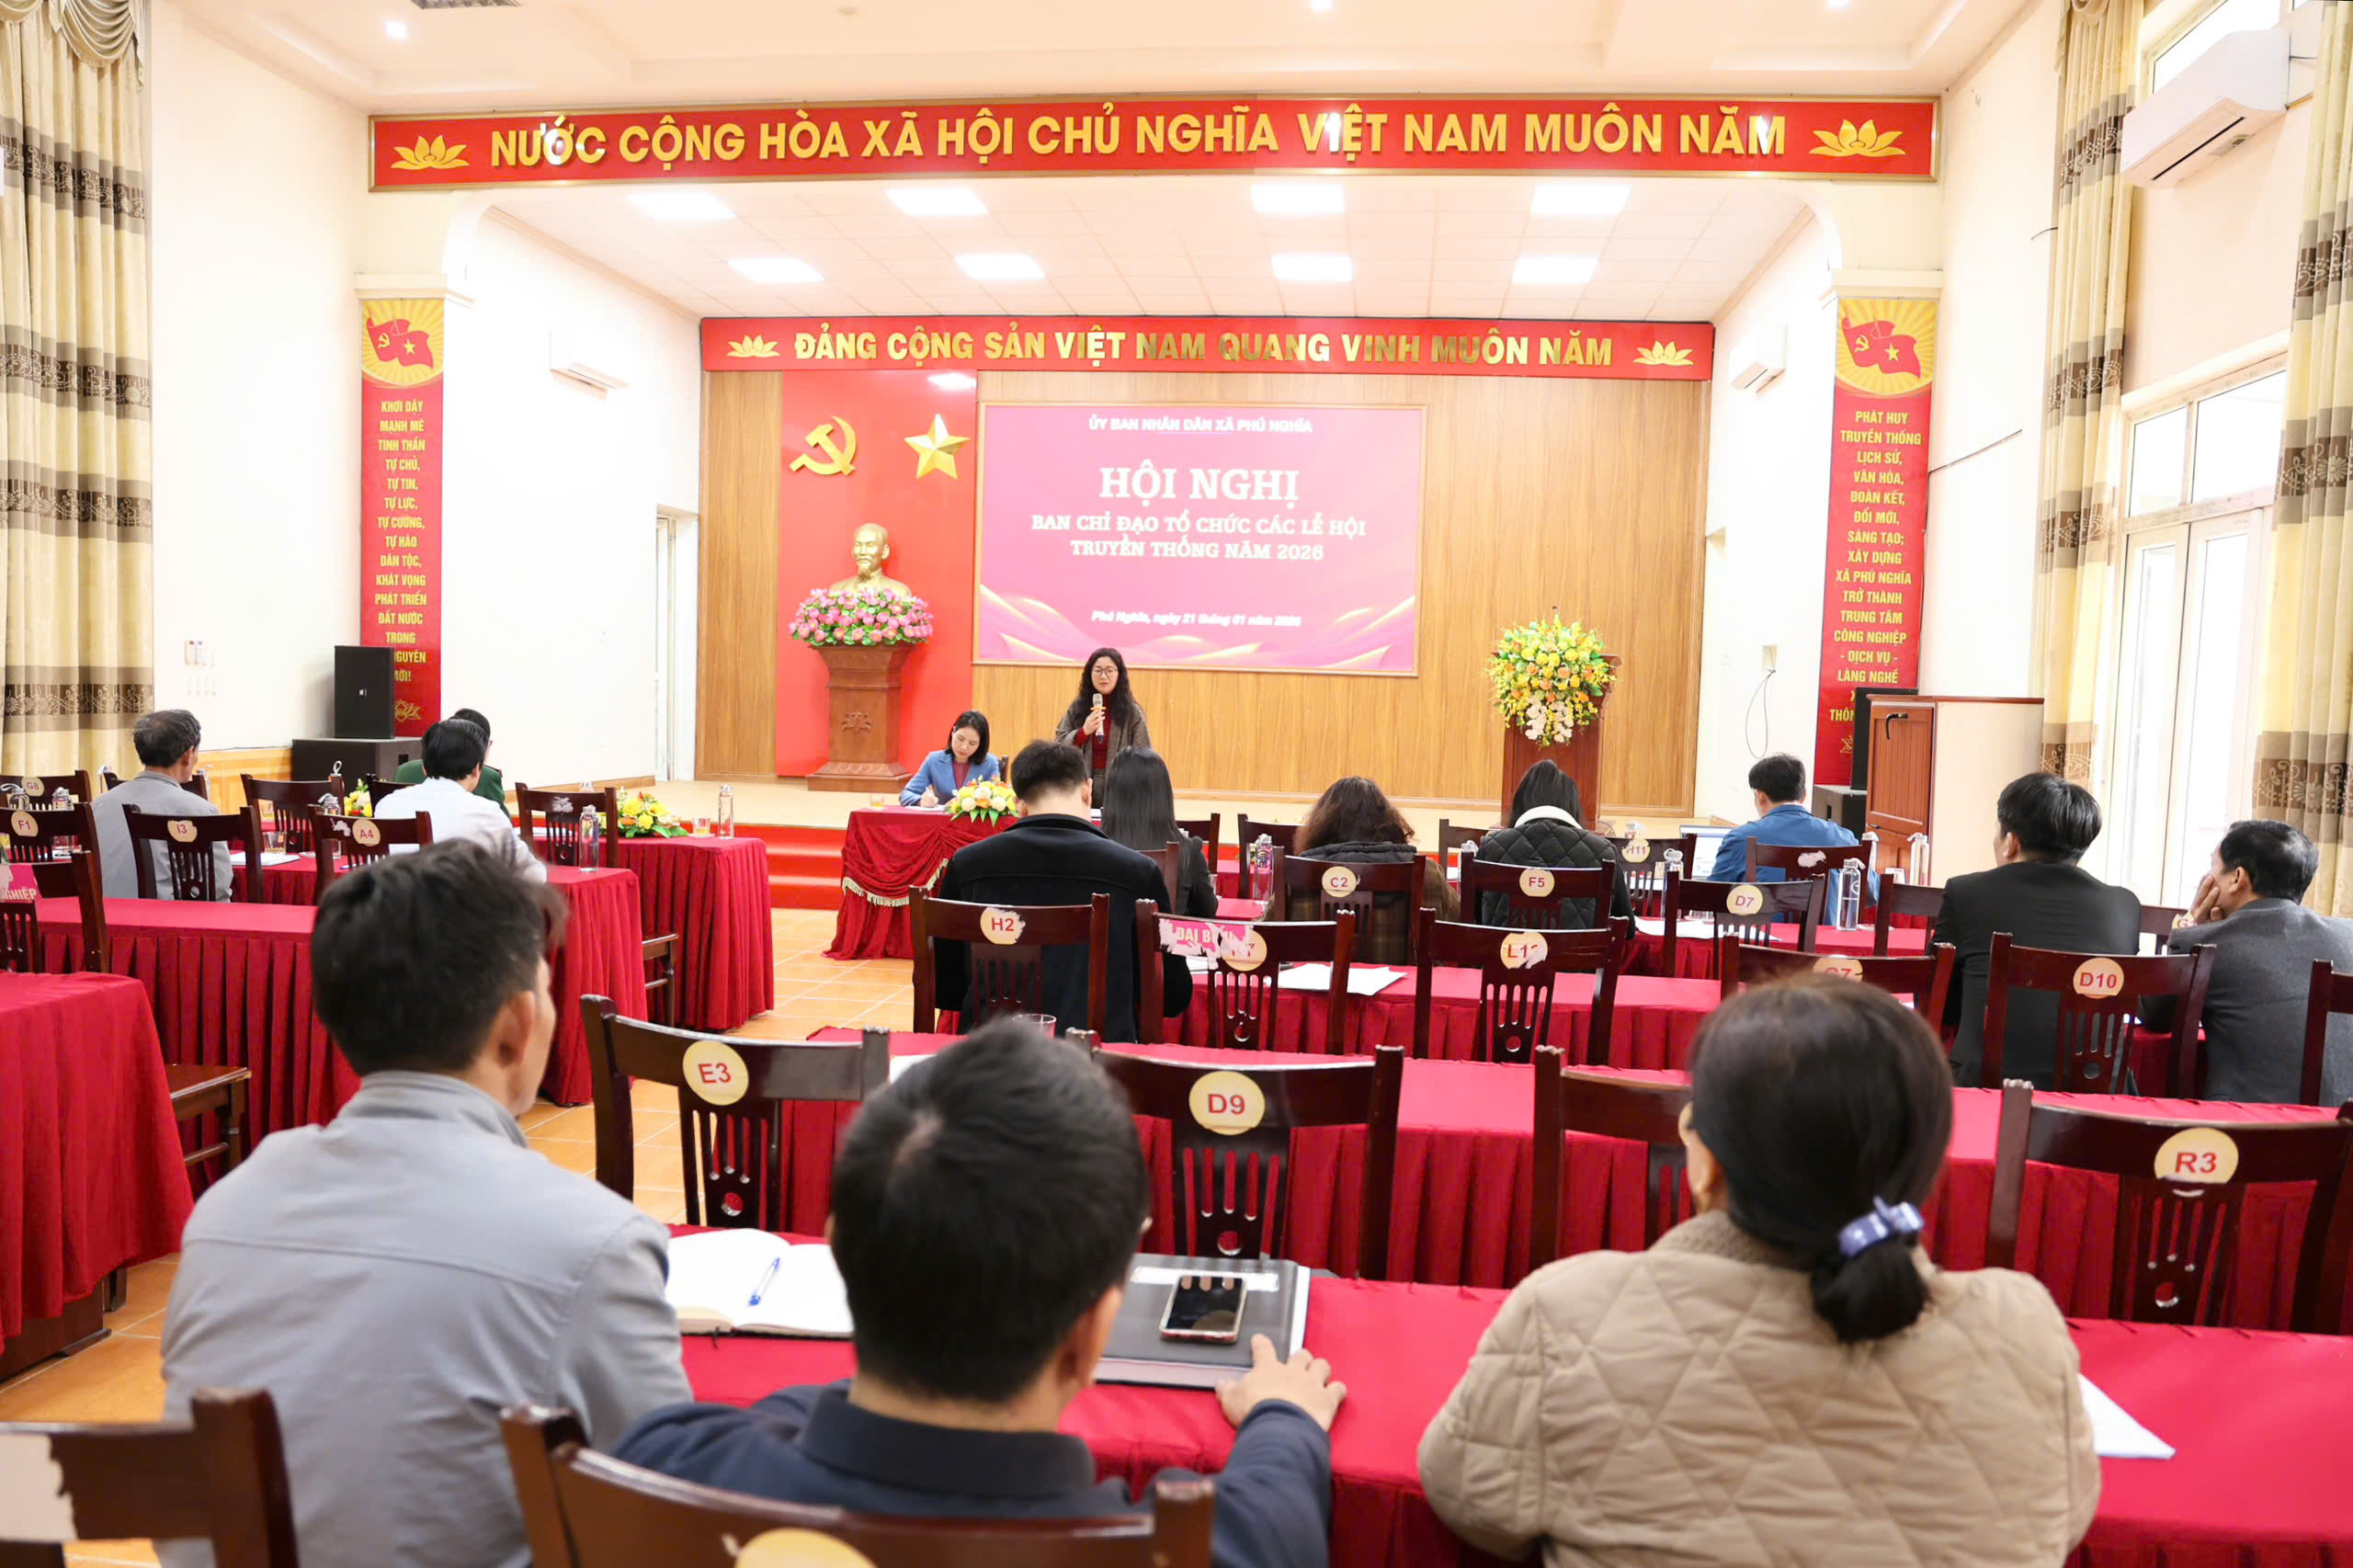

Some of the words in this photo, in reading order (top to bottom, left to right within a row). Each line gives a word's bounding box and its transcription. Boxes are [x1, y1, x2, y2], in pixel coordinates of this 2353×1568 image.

[490, 116, 607, 167] NƯỚC
[620, 114, 745, 171] CỘNG
[759, 108, 848, 160] HÒA
[861, 111, 922, 158] XÃ
[938, 107, 1014, 165] HỘI
[1028, 102, 1120, 155] CHỦ
[1135, 105, 1279, 154] NGHĨA
[1299, 103, 1386, 162] VIỆT
[1404, 113, 1508, 154] NAM
[1524, 102, 1662, 154] MUÔN
[1679, 105, 1786, 156] NĂM
[794, 323, 877, 360] ĐẢNG
[887, 324, 973, 367] CỘNG
[984, 322, 1045, 360] SẢN
[1055, 324, 1126, 367] VIỆT
[1136, 332, 1206, 361] NAM
[1218, 333, 1330, 362] QUANG
[1343, 335, 1420, 363] VINH
[1430, 327, 1529, 366] MUÔN
[1539, 330, 1612, 367] NĂM
[1856, 409, 1883, 424] PHÁT
[1886, 412, 1908, 424] HUY
[380, 420, 408, 434] MẠNH
[1110, 418, 1139, 430] BAN
[1142, 416, 1180, 431] NHÂN
[1183, 416, 1212, 431] DÂN
[1237, 417, 1265, 432] PHÚ
[1269, 417, 1314, 433] NGHĨA
[378, 439, 399, 451] TINH
[1858, 450, 1881, 466] LỊCH
[385, 459, 398, 473] TỰ
[387, 477, 399, 492] TỰ
[401, 478, 418, 490] TIN,
[1098, 460, 1176, 506] HỘI
[1189, 470, 1300, 509] NGHỊ
[384, 497, 397, 512] TỰ
[377, 517, 390, 531] TỰ
[1031, 515, 1071, 531] BAN
[1076, 511, 1111, 532] CHỈ
[1117, 516, 1159, 535] ĐẠO
[1165, 510, 1190, 532] TỔ
[1196, 514, 1250, 535] CHỨC
[1256, 514, 1295, 536] CÁC
[1301, 512, 1324, 536] LỄ
[1329, 517, 1368, 540] HỘI
[385, 536, 397, 551] TỰ
[1847, 529, 1877, 544] SÁNG
[1071, 535, 1145, 558] TRUYỀN
[1151, 537, 1220, 559] THỐNG
[1224, 540, 1271, 560] NĂM
[376, 573, 399, 585] KHÁT
[402, 574, 426, 588] VỌNG
[1853, 569, 1875, 584] PHÚ
[375, 591, 398, 606] PHÁT
[1840, 609, 1876, 624] TRUNG
[1880, 610, 1903, 625] TÂM
[385, 631, 416, 643] TRONG
[1835, 629, 1863, 642] CÔNG
[1867, 631, 1907, 646] NGHIỆP
[394, 649, 426, 663] GUYÊN
[1847, 651, 1873, 665] DỊCH
[1877, 652, 1892, 665] VỤ
[1837, 669, 1866, 682] LÀNG
[18, 820, 30, 830] F1
[359, 829, 374, 839] A4
[1330, 877, 1348, 888] C2
[1528, 875, 1545, 888] F5
[1733, 895, 1755, 908] D7
[990, 916, 1015, 933] H2
[2079, 971, 2118, 990] D10
[698, 1062, 731, 1084] E3
[1207, 1093, 1245, 1116] D9
[2175, 1152, 2216, 1174] R3
